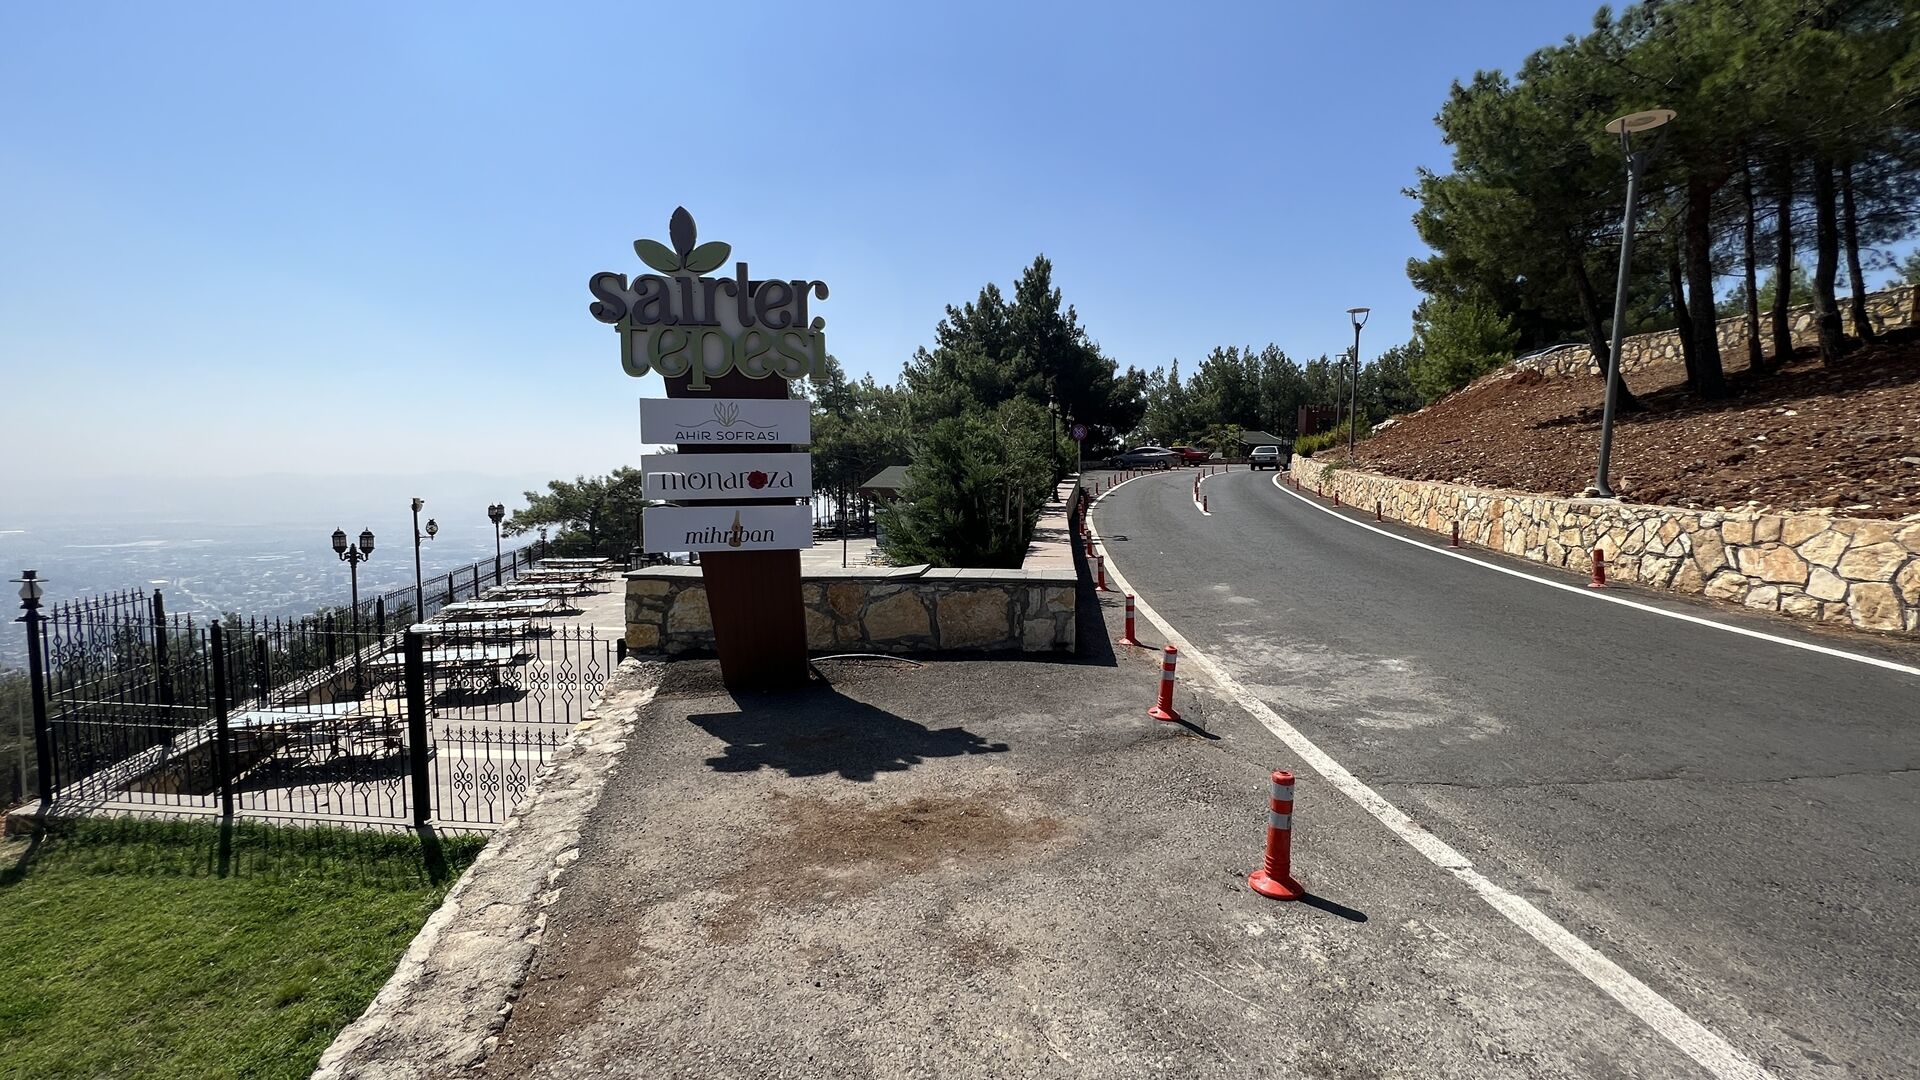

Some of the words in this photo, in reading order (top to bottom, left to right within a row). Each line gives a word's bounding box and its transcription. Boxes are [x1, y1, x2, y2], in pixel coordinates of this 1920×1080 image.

[615, 313, 828, 391] tepesi
[716, 431, 779, 441] SOFRASI
[685, 525, 775, 545] mihriban
